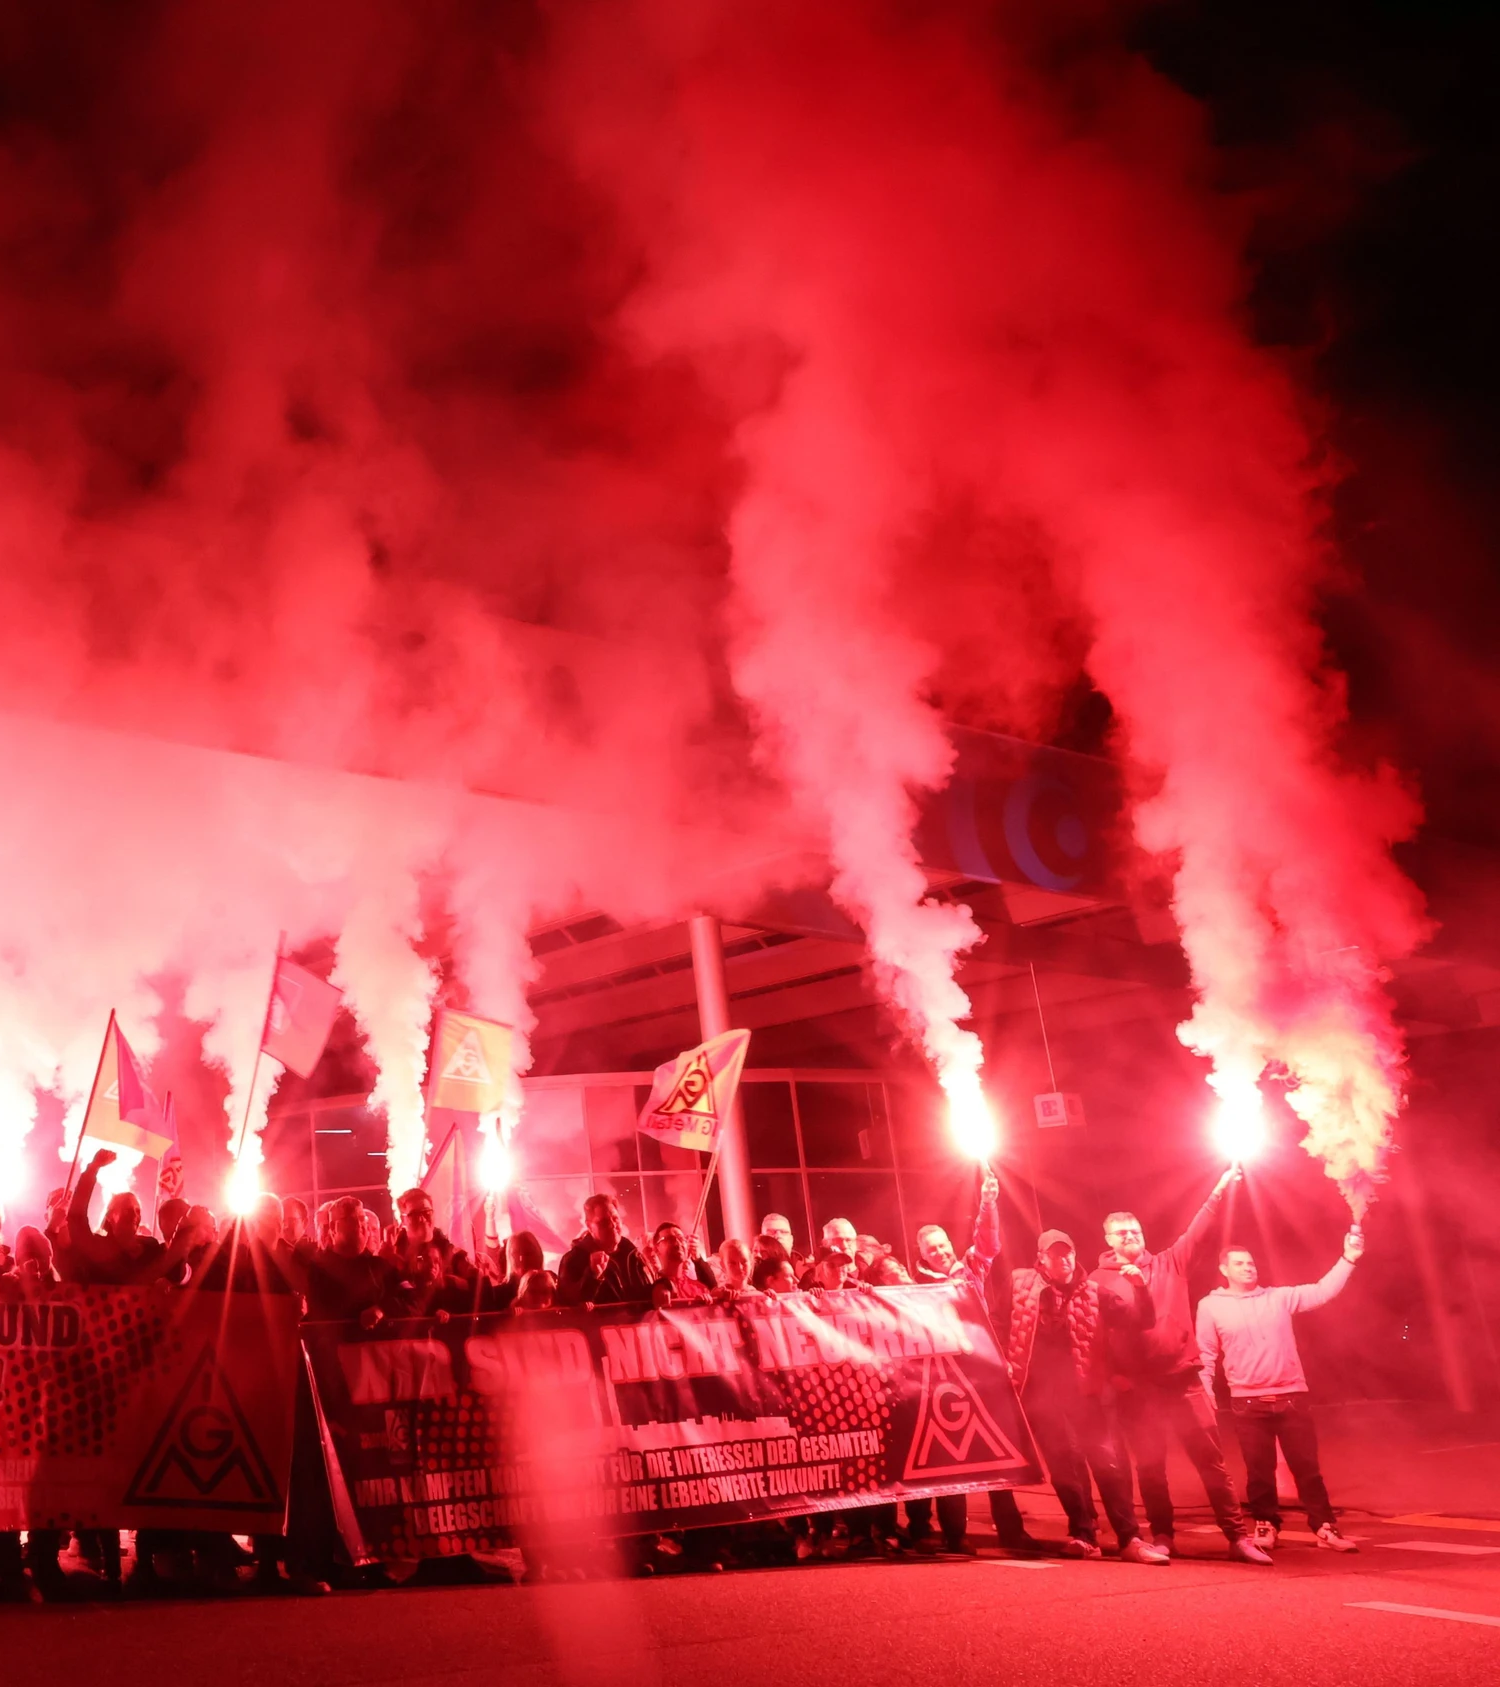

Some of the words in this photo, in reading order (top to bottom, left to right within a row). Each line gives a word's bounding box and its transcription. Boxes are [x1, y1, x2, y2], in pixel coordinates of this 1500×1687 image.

[602, 1321, 741, 1381] NICHT
[355, 1478, 398, 1507] WIR
[400, 1468, 487, 1503] KÄMPFEN
[609, 1449, 644, 1484] FÜR
[645, 1450, 675, 1479] DIE
[673, 1441, 764, 1476] INTERESSEN
[767, 1438, 797, 1467] DER
[800, 1430, 880, 1462] GESAMTEN
[621, 1484, 659, 1514] EINE
[661, 1472, 767, 1510] LEBENSWERTE
[767, 1463, 841, 1496] ZUKUNFT!
